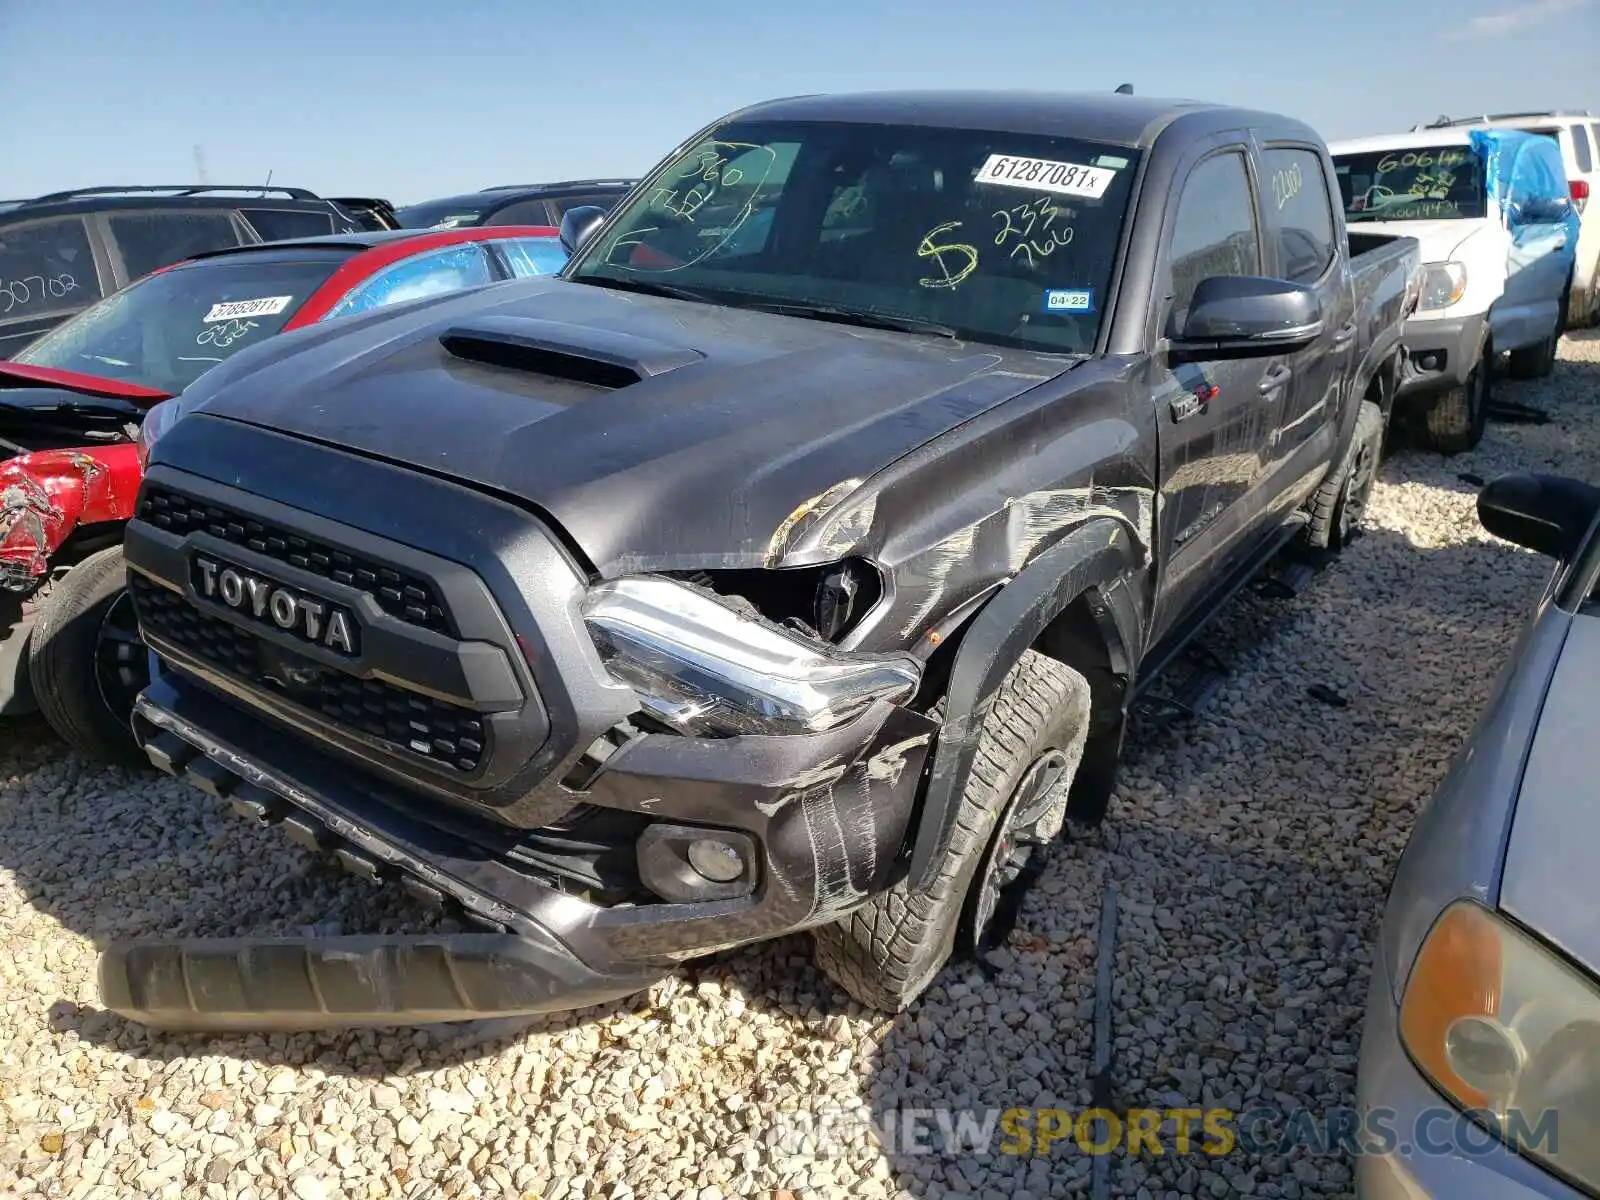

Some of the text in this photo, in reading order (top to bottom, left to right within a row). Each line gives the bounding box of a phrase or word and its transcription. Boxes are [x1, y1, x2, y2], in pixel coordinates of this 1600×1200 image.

[991, 196, 1059, 245] 233
[1010, 226, 1074, 270] 766
[197, 557, 352, 653] TOYOTA
